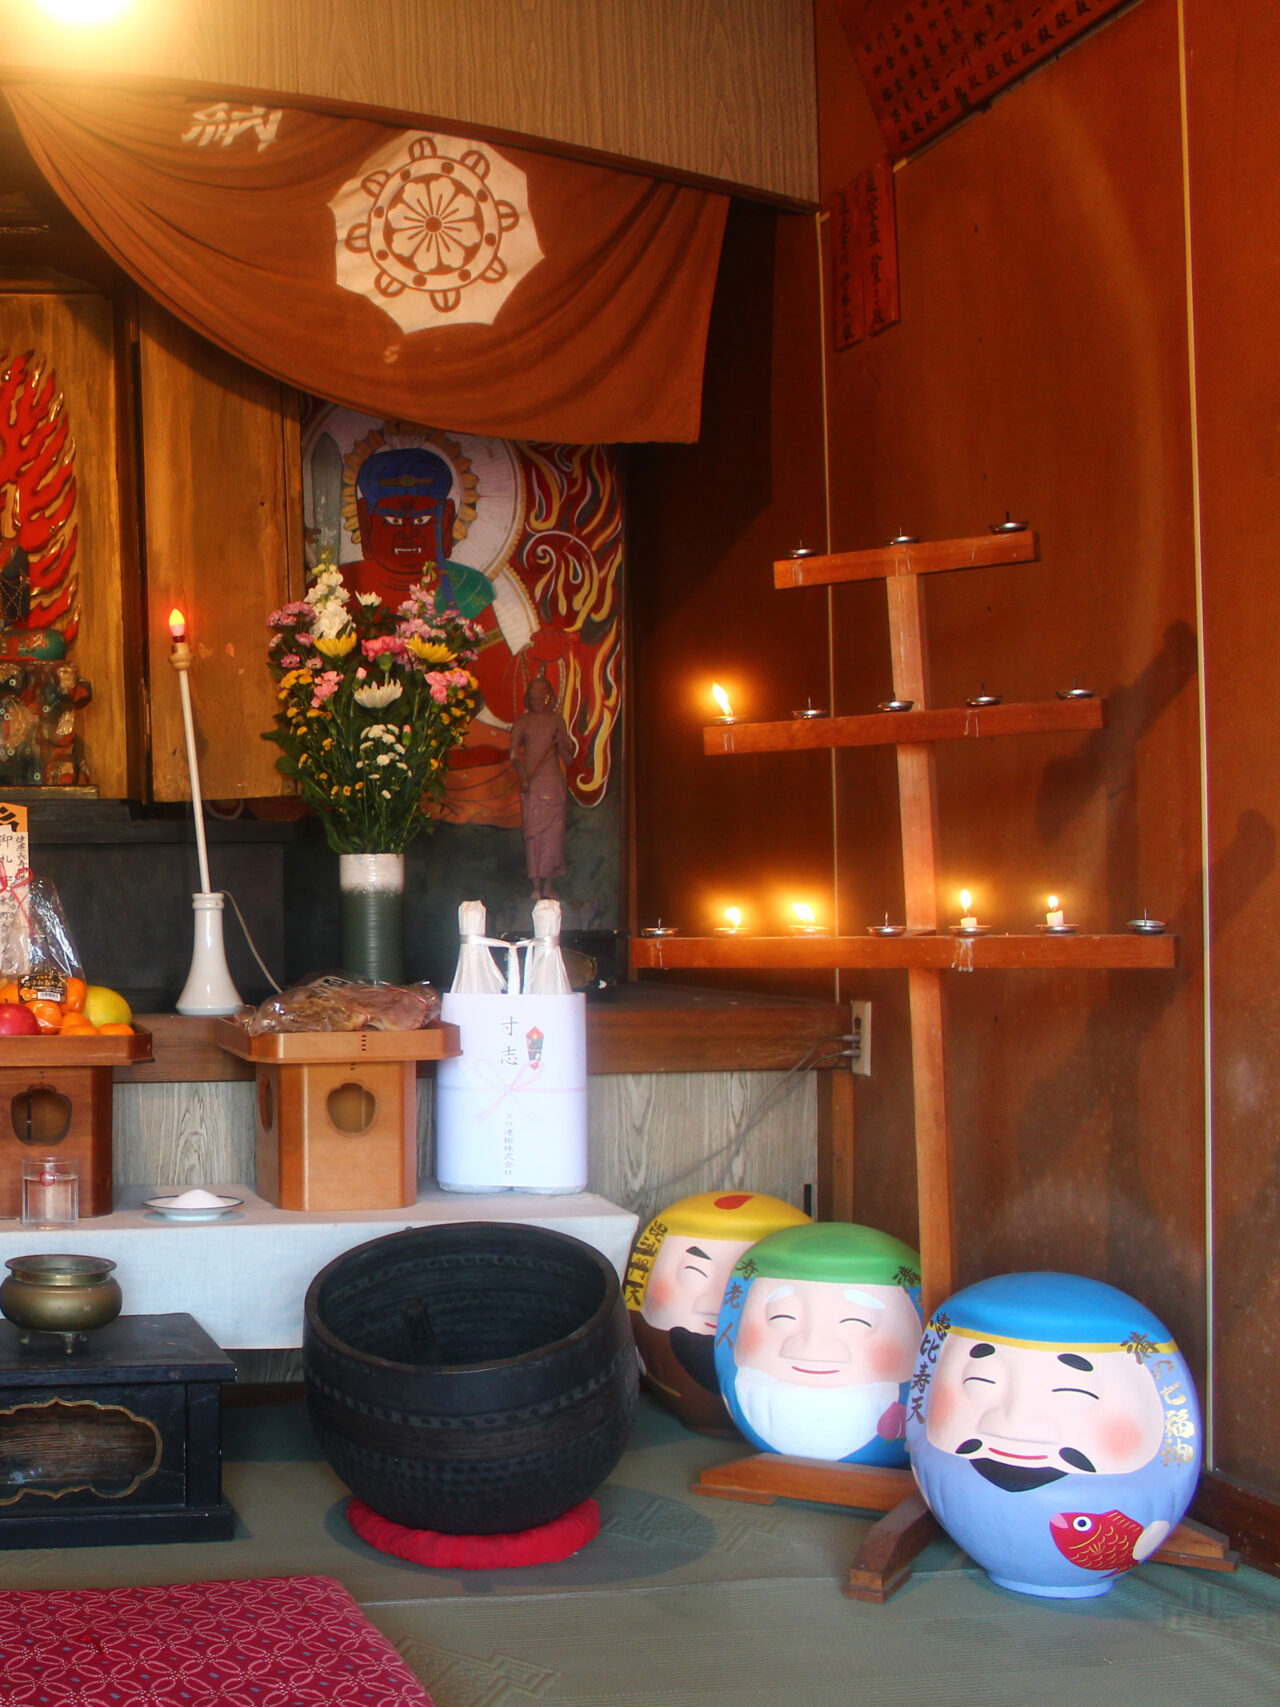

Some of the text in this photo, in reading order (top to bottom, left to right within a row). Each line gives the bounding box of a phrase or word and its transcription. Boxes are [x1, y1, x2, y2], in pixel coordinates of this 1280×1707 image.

[500, 1016, 519, 1066] 寸志
[716, 1258, 759, 1349] 寿老人
[905, 1311, 952, 1425] 恵比寿天
